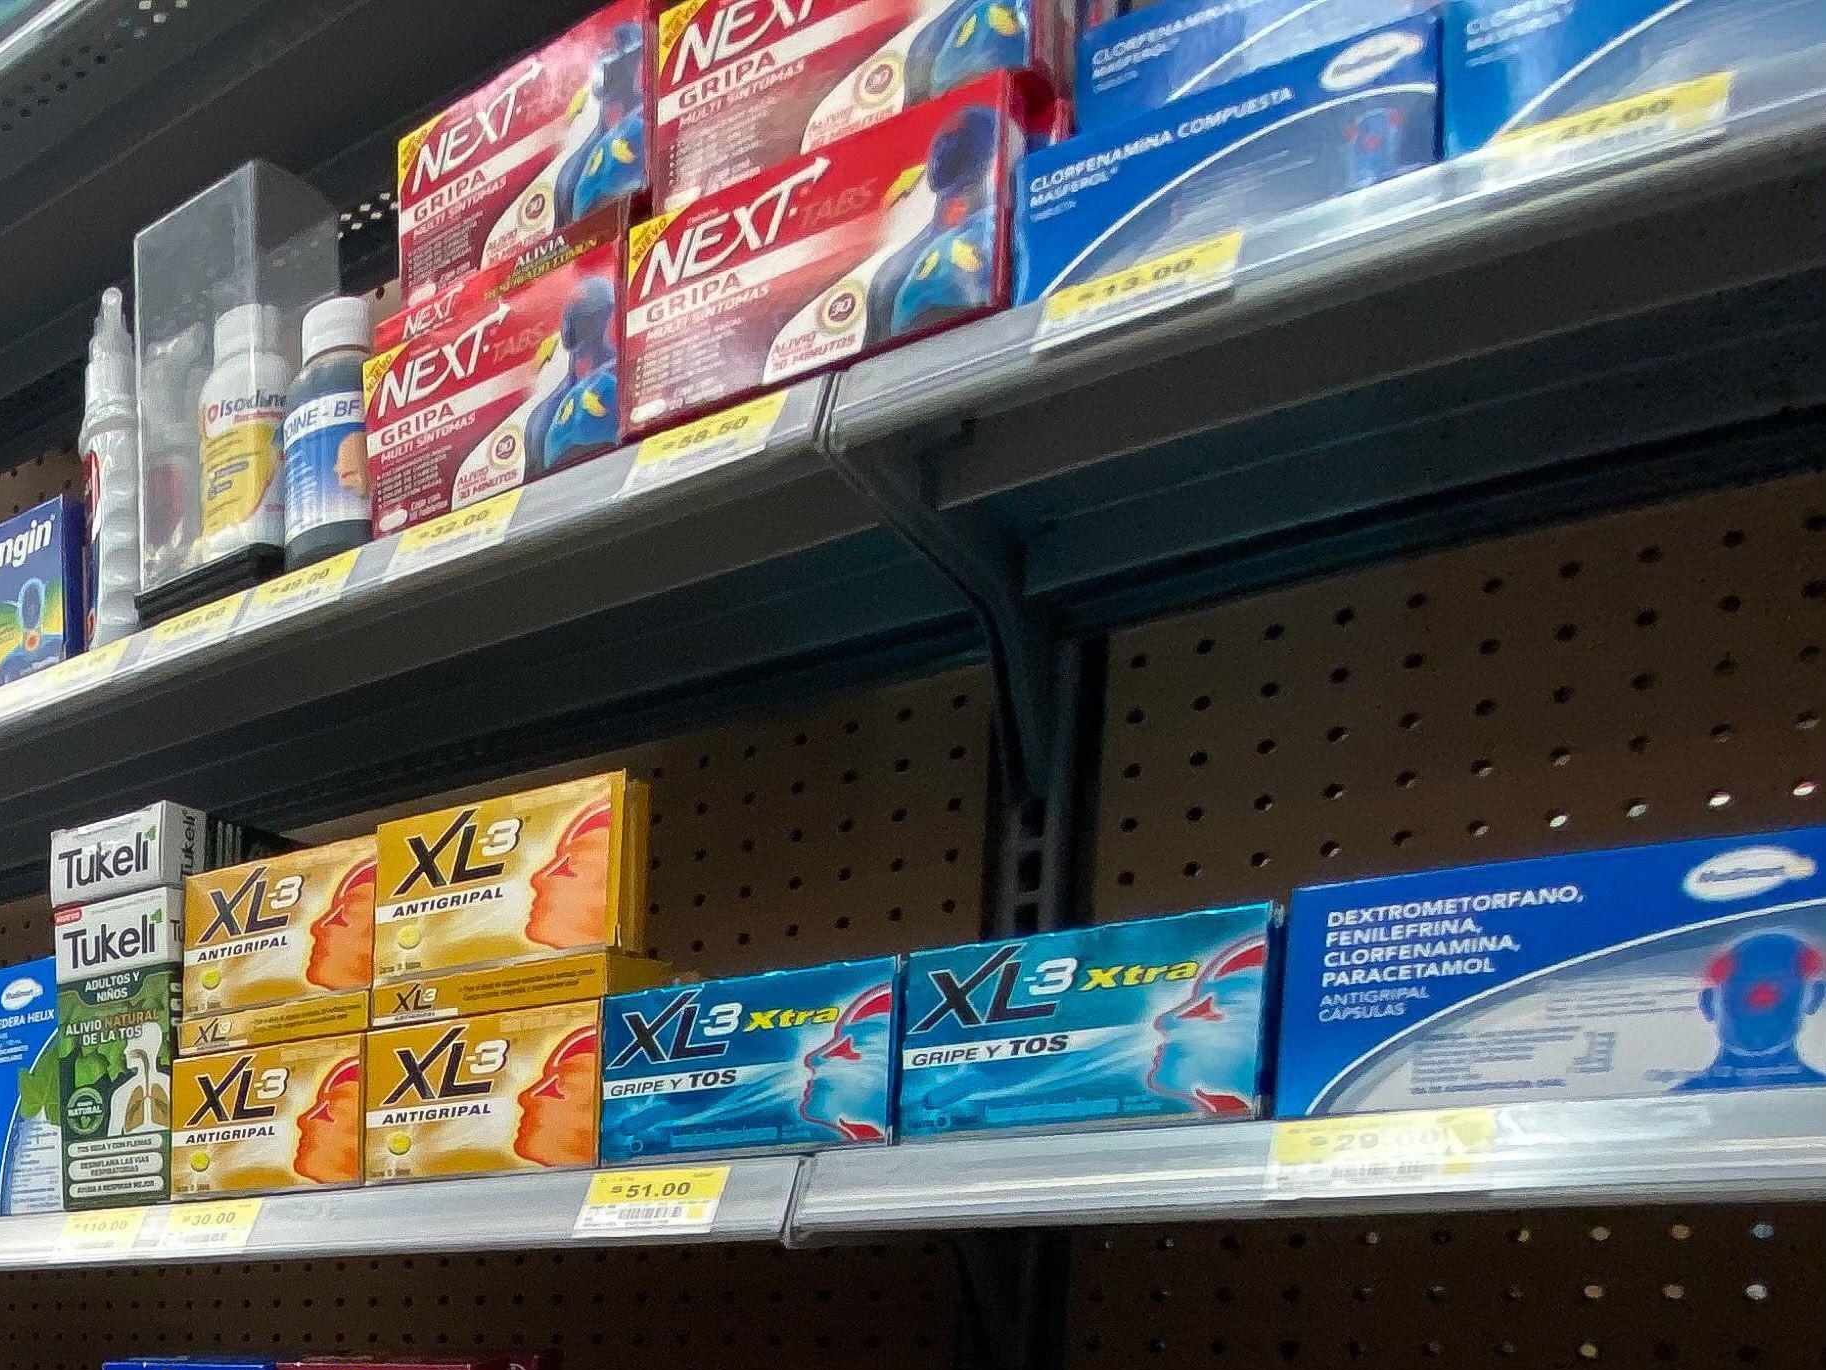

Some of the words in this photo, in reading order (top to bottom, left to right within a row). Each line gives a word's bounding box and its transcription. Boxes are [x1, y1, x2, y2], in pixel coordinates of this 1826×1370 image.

[412, 61, 543, 193] NEXT
[1177, 88, 1294, 138] COMPUESTA
[414, 171, 486, 221] GRIPA
[639, 157, 830, 299] NEXT
[646, 272, 743, 322] GRIPA
[377, 301, 510, 418] NEXT
[380, 402, 454, 446] GRIPA
[59, 826, 157, 889] Tukeli
[392, 887, 504, 919] ANTIGRIPAL
[1327, 886, 1584, 928] DEXTROMETORFANO,
[63, 908, 162, 969] Tukeli
[1326, 917, 1482, 947] FENILEFRINA,
[197, 935, 288, 964] ANTIGRIPAL
[1324, 934, 1521, 969] CLORFENAMINA,
[85, 974, 131, 992] ADULTOS
[132, 971, 139, 982] Y
[1082, 960, 1199, 991] Xtra
[1322, 959, 1495, 987] PARACETAMOL
[97, 989, 127, 1003] NIÑOS
[1321, 986, 1428, 1007] ANTIGRIPAL
[28, 1009, 54, 1024] HELIX
[66, 1020, 102, 1036] ALIVIO
[743, 1005, 839, 1033] Xtra
[83, 1033, 98, 1046] DE
[101, 1031, 115, 1043] LA
[119, 1027, 143, 1040] TOS
[911, 1048, 979, 1067] GRIPE
[985, 1043, 1001, 1060] Y
[1008, 1036, 1068, 1057] TOS
[611, 1077, 664, 1098] GRIPE
[668, 1075, 682, 1090] Y
[688, 1069, 737, 1089] TOS
[382, 1103, 492, 1125] ANTIGRIPAL
[185, 1126, 276, 1145] ANTIGRIPAL
[611, 1181, 691, 1198] $51.00
